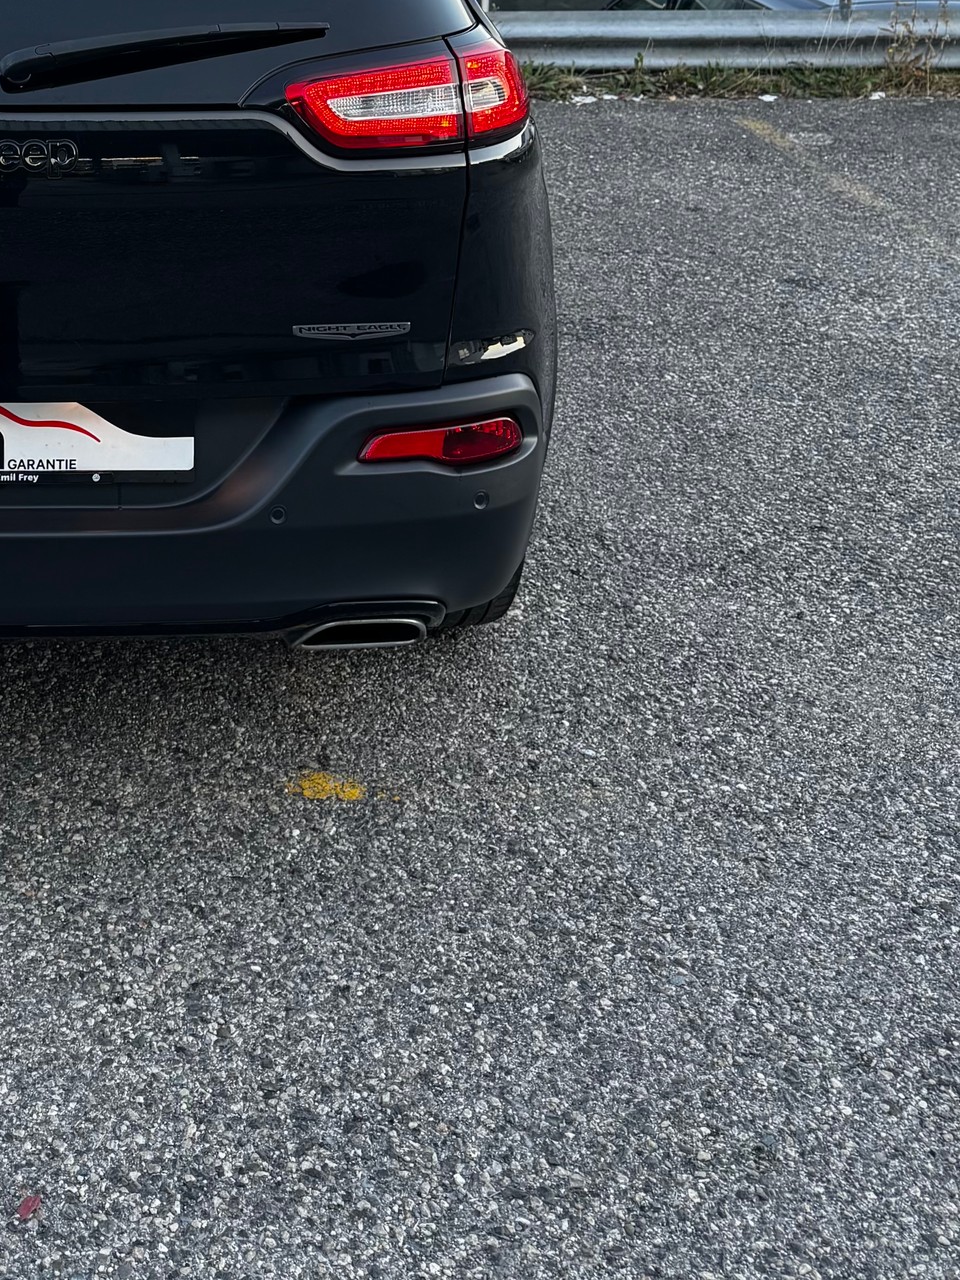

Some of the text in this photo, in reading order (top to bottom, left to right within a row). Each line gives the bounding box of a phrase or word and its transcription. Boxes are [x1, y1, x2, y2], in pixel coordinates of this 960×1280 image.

[298, 325, 351, 334] NIGHT
[7, 458, 77, 470] GARANTIE
[18, 473, 39, 484] Frey
